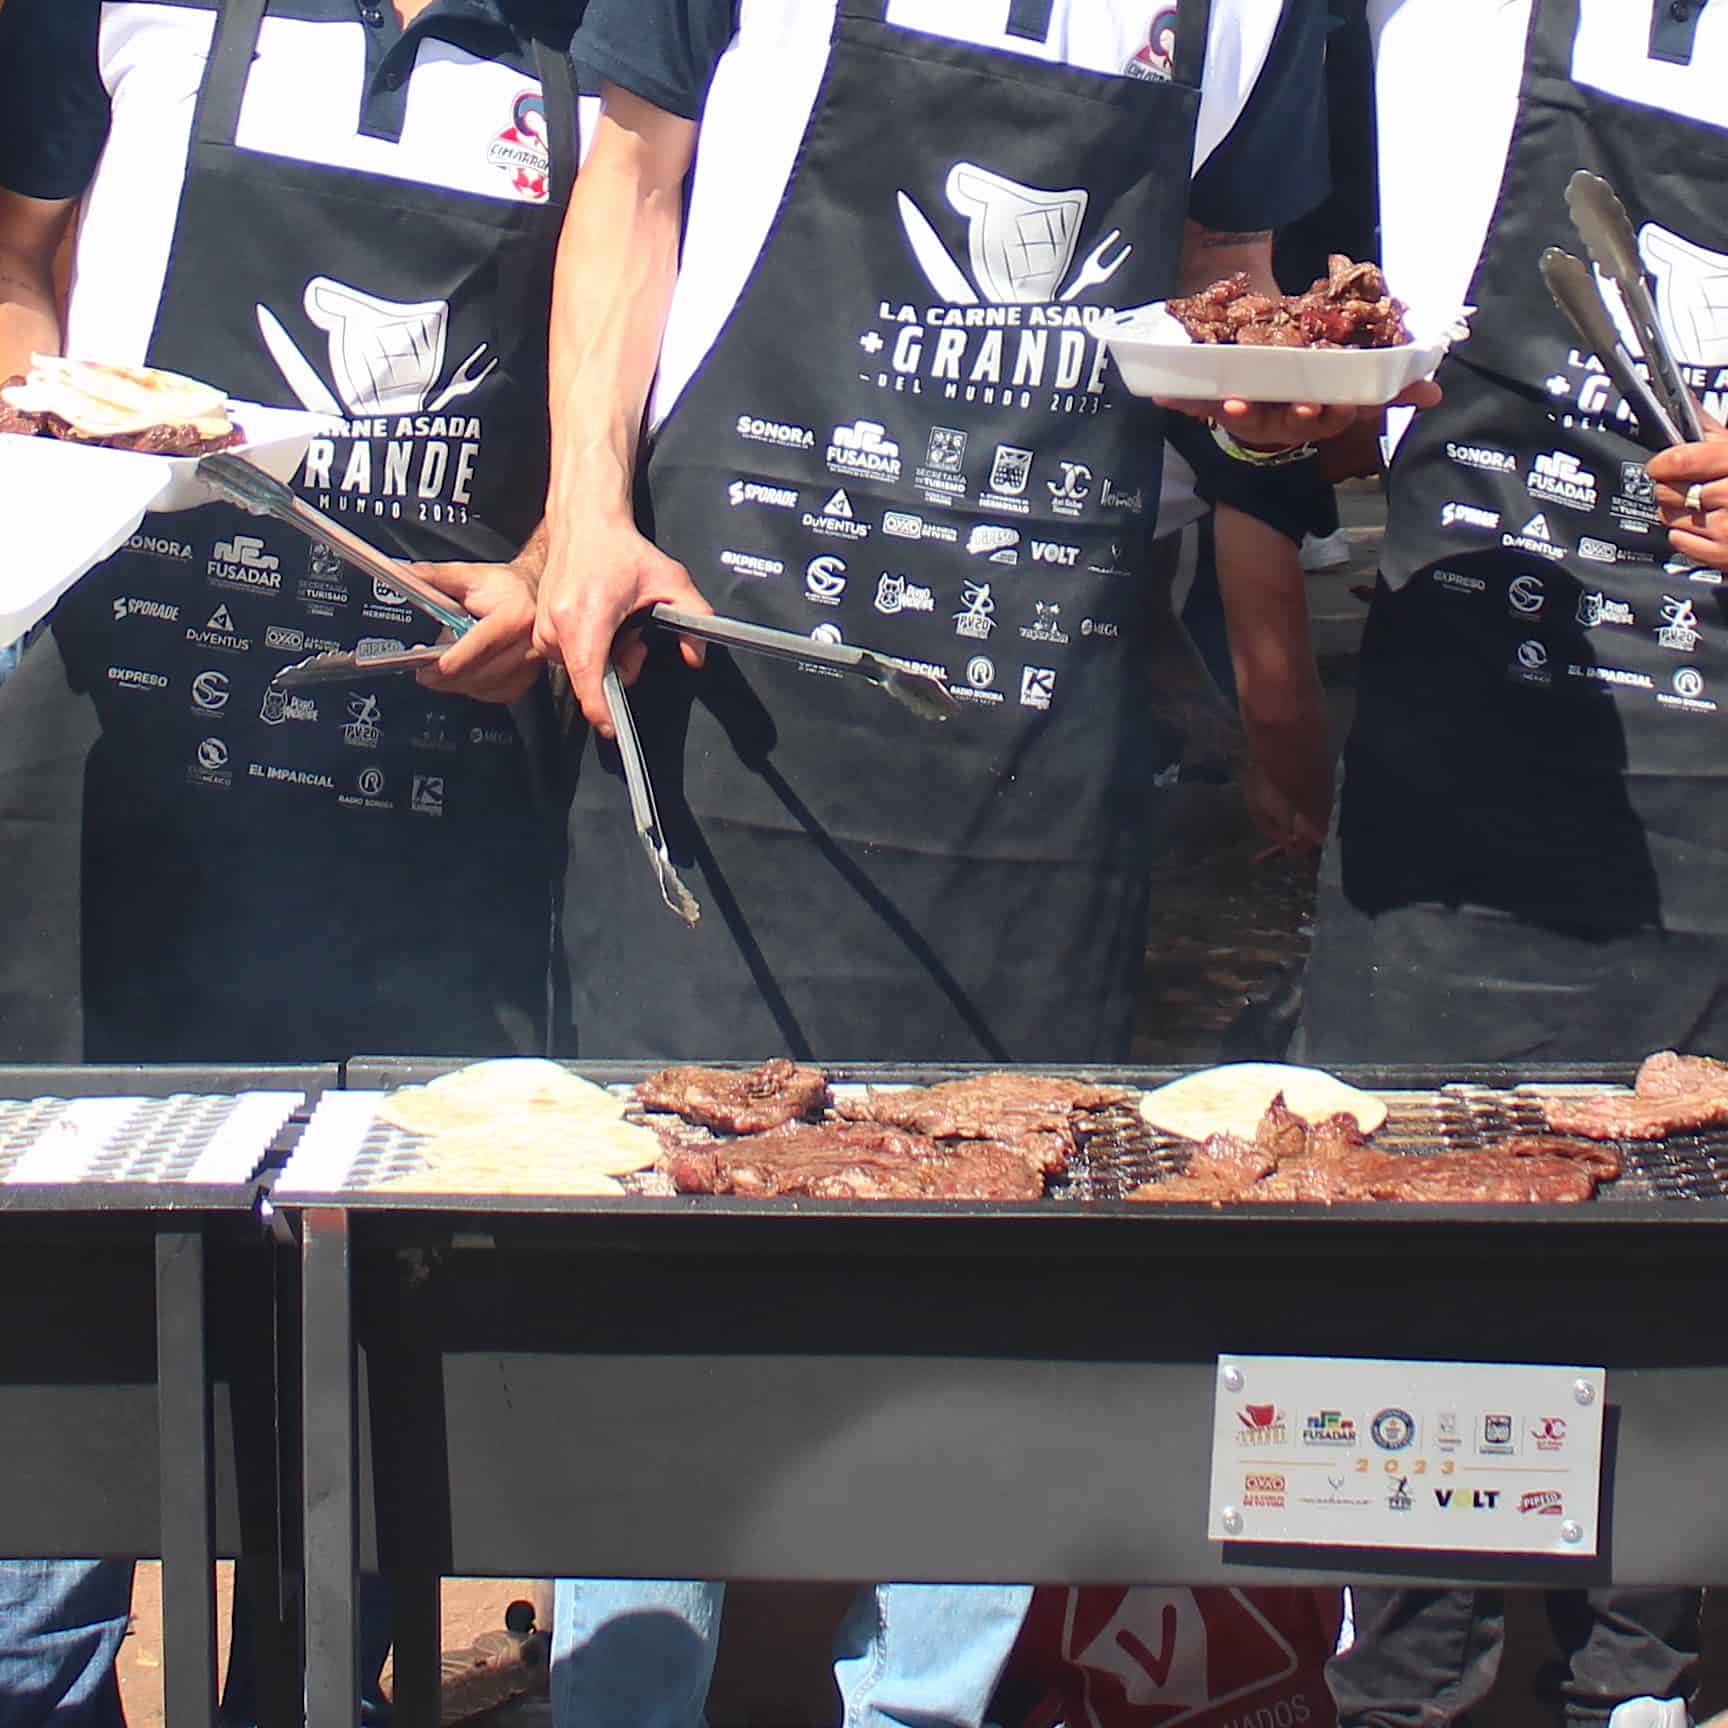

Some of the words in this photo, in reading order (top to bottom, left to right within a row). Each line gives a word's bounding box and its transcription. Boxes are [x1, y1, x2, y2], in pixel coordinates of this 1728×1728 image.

[879, 302, 918, 322] LA
[927, 307, 1022, 326] CARNE
[1568, 349, 1605, 372] LA
[878, 374, 921, 393] DEL
[945, 383, 1031, 408] MUNDO
[1051, 395, 1099, 414] 2023
[395, 417, 481, 439] ASADA
[737, 416, 815, 446] SONORA
[1563, 414, 1607, 432] DEL
[827, 446, 902, 475] FUSADAR
[1446, 443, 1517, 471] SONORA
[304, 439, 480, 505] RANDE
[744, 483, 799, 508] SPORADE
[1527, 472, 1597, 504] FUSADAR
[320, 495, 401, 519] MUNDO
[419, 503, 468, 523] 2023
[1031, 540, 1081, 565] VOLT
[207, 560, 282, 588] FUSADAR
[128, 598, 180, 622] SPORADE
[248, 762, 266, 776] EL
[267, 765, 335, 788] IMPARCIAL
[1434, 1487, 1501, 1508] VOLT
